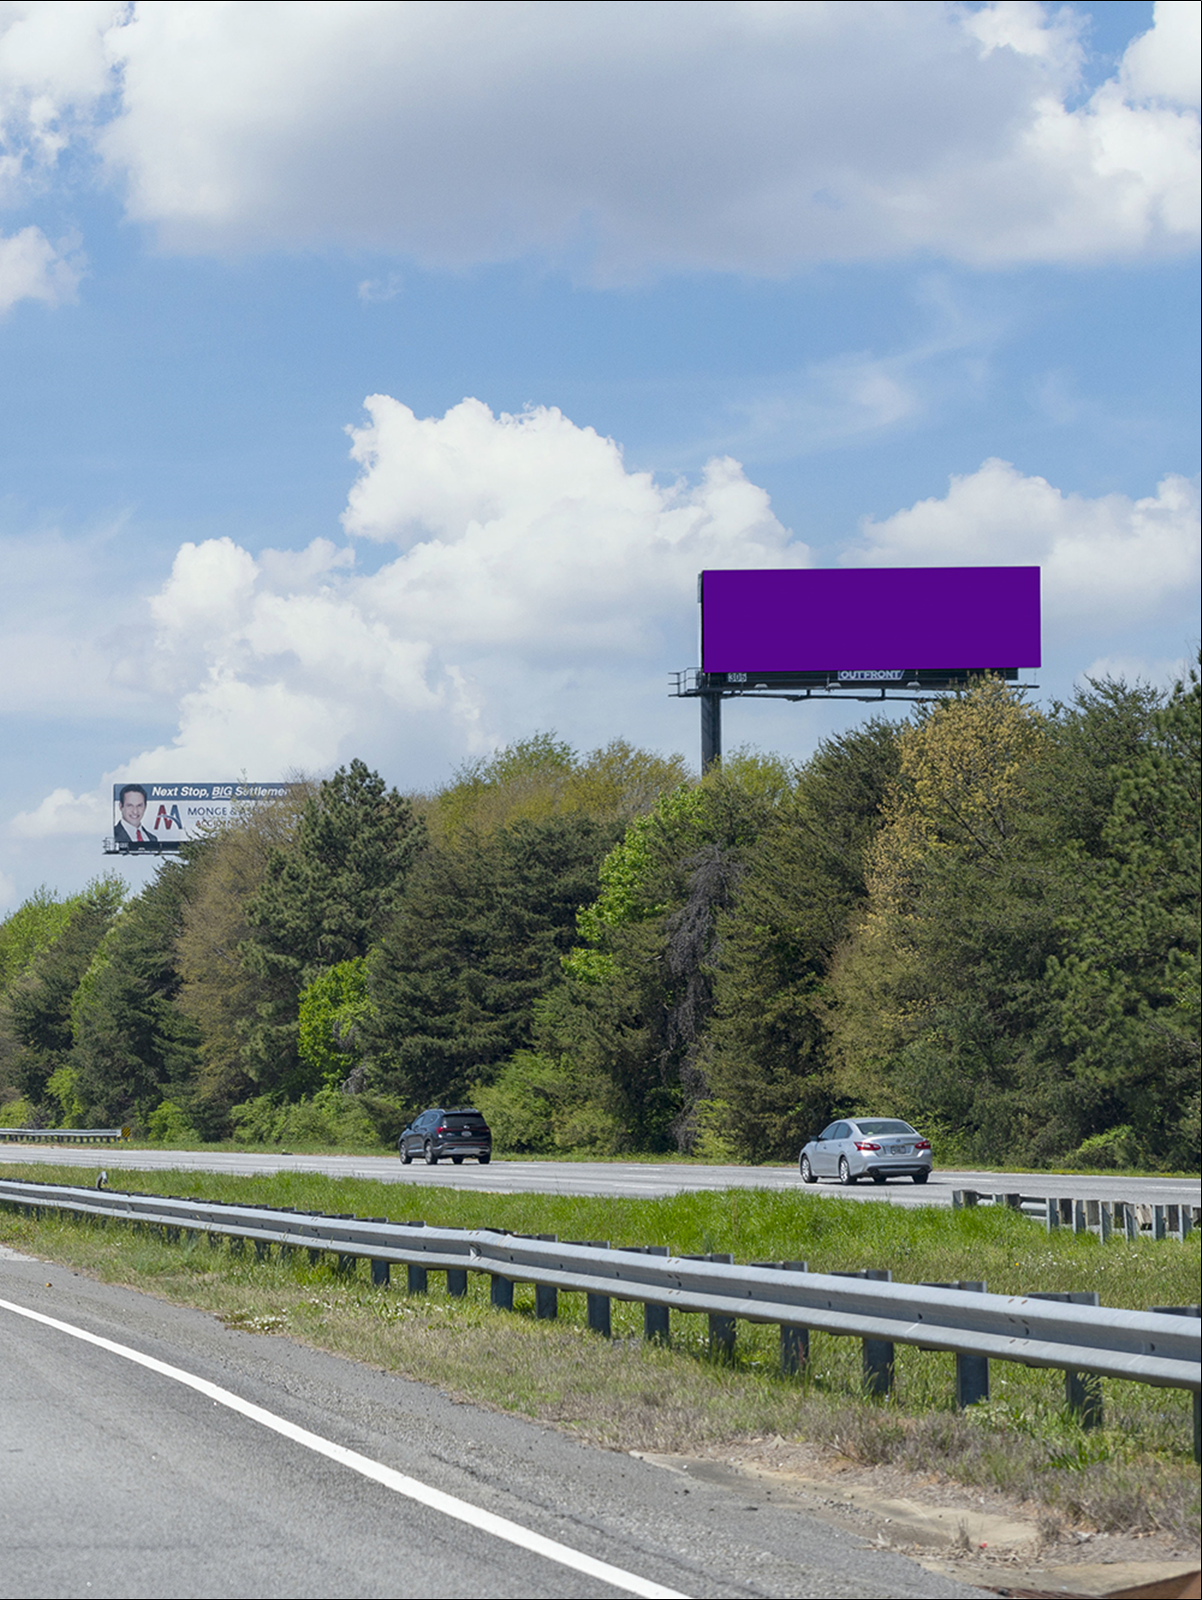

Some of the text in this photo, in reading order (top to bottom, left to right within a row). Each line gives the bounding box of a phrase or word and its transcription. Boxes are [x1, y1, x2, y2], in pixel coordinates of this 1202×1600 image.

[840, 670, 901, 679] OUTFRONT
[151, 786, 178, 797] Next
[180, 786, 209, 799] Stop,
[211, 786, 233, 797] BIG
[187, 807, 227, 816] MONGE
